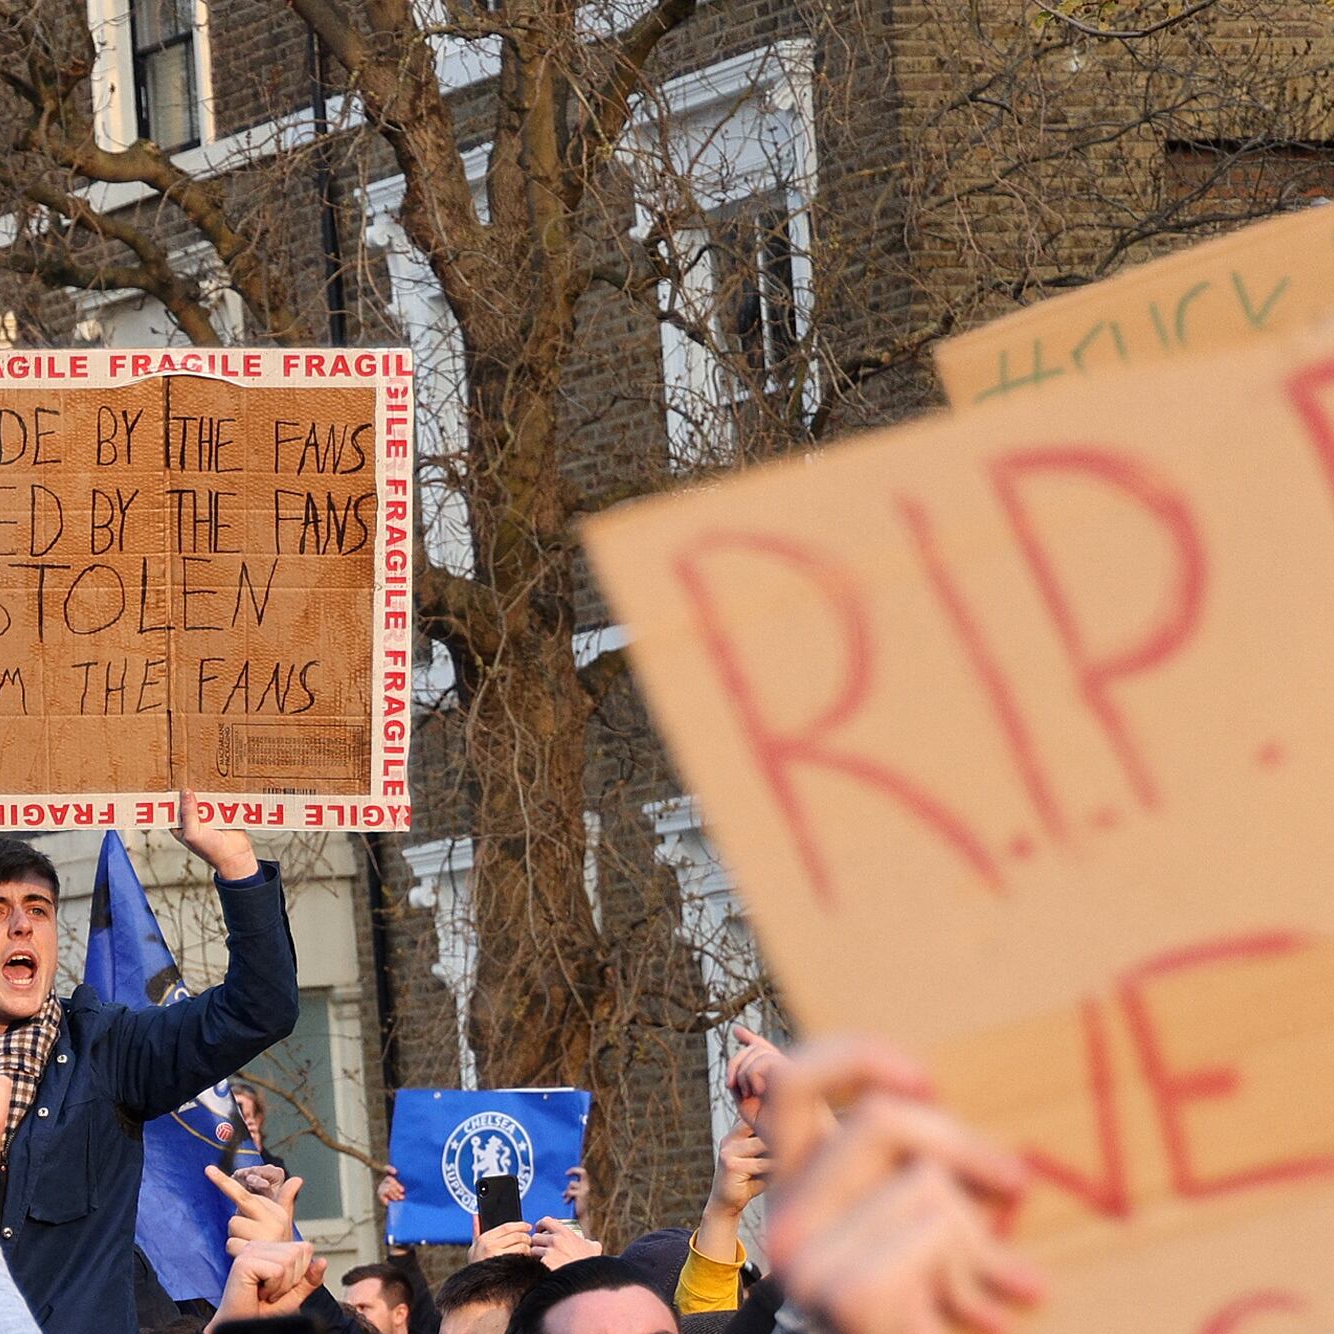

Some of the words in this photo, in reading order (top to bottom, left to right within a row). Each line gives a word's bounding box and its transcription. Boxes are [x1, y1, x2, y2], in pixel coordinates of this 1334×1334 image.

[109, 354, 262, 377] FRAGILE
[97, 405, 143, 466] BY
[171, 416, 243, 473] THE
[275, 420, 373, 476] FANS
[91, 488, 139, 555] BY
[167, 489, 241, 554] THE
[275, 489, 378, 556] FANS
[384, 480, 408, 630] FRAGILE
[71, 657, 167, 716] THE
[199, 657, 321, 715] FANS
[382, 650, 406, 796] FRAGILE
[136, 802, 284, 825] FRAGLE
[463, 1114, 517, 1135] CHELSEA
